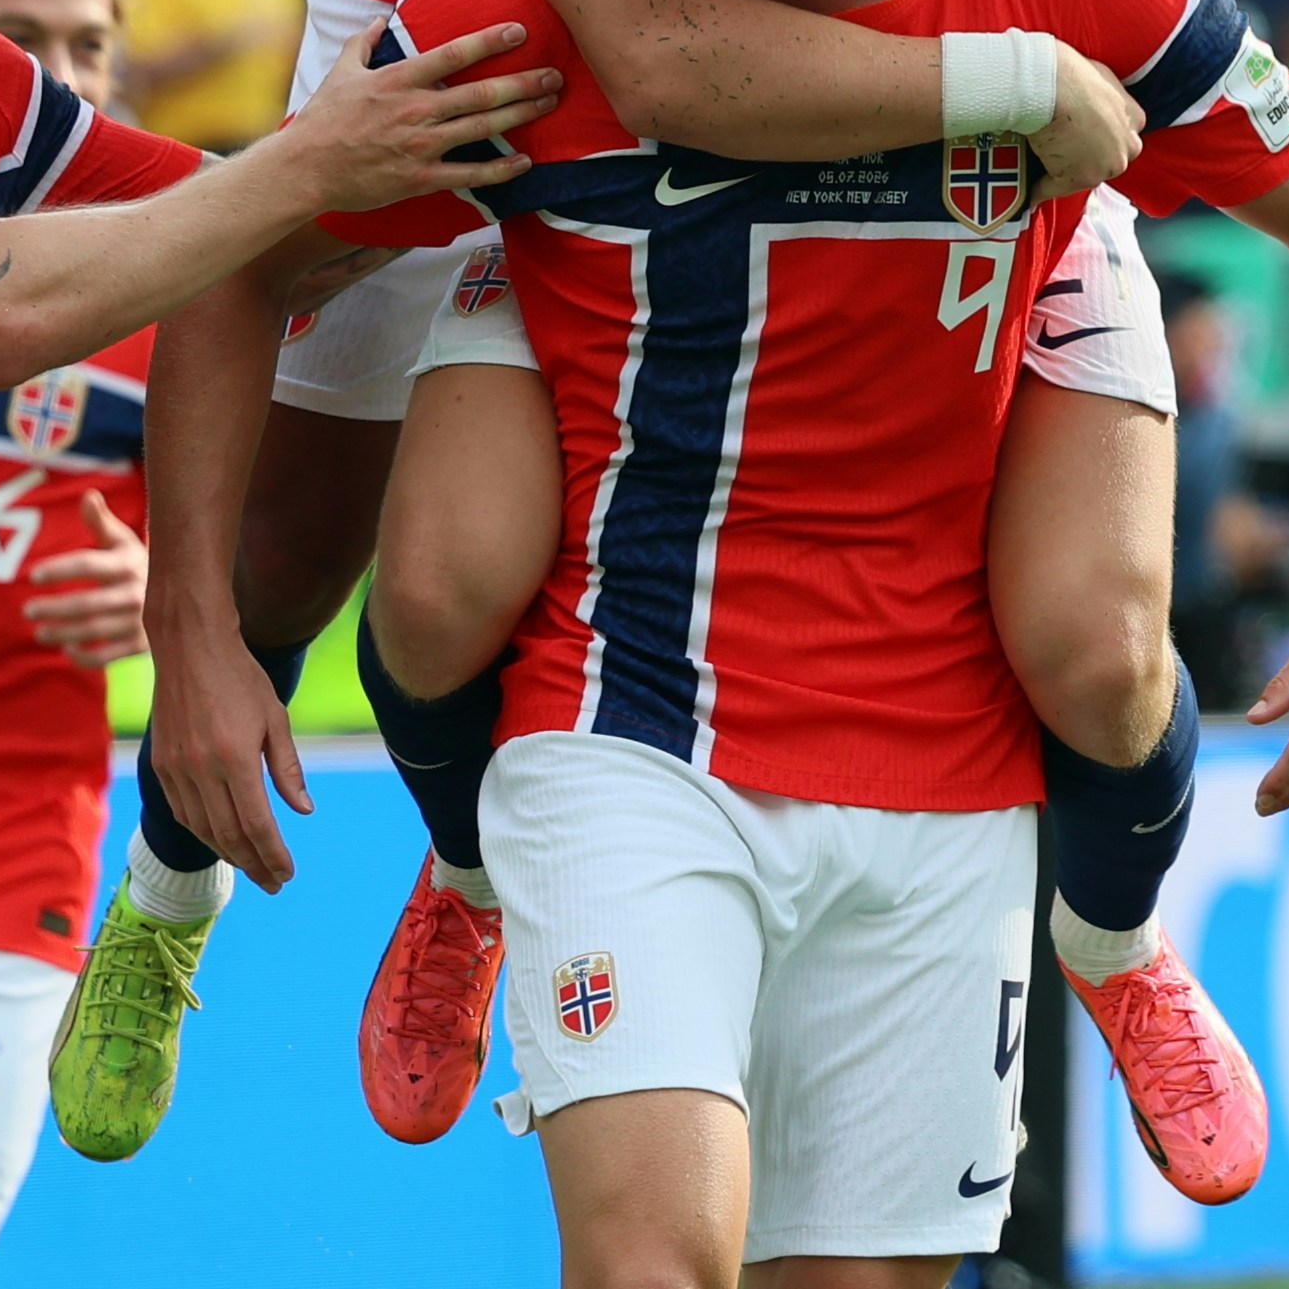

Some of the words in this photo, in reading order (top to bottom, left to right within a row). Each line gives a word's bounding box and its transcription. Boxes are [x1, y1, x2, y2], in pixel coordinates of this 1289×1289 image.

[818, 170, 889, 184] 05.07.2026
[786, 190, 811, 204] NEW
[813, 190, 844, 204] YORK
[846, 190, 872, 204] NEW
[937, 241, 1016, 373] 9
